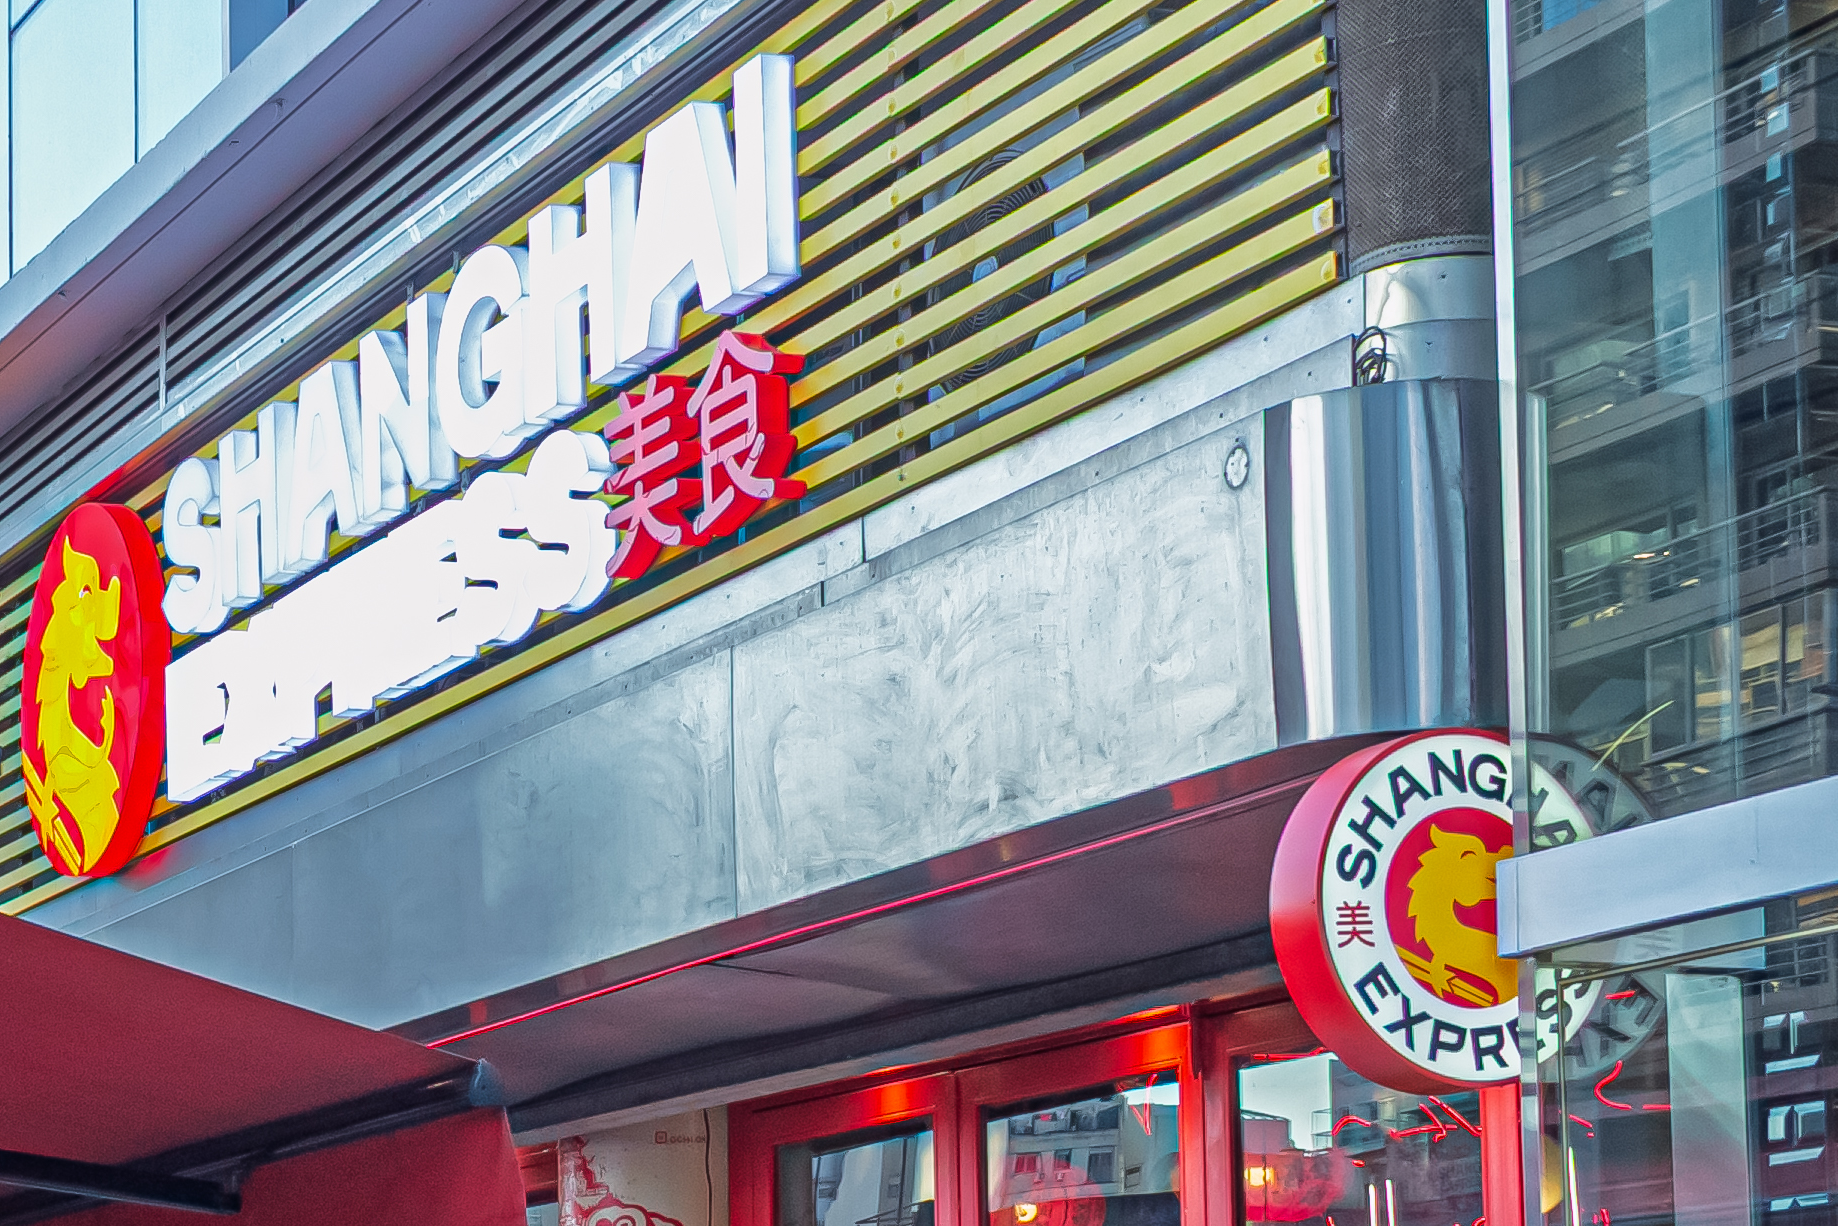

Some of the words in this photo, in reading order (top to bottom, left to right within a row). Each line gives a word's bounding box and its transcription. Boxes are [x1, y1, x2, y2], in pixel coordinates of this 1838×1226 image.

[163, 53, 801, 634] SHANGHAI
[605, 330, 807, 579] 美食
[1336, 900, 1375, 949] 美
